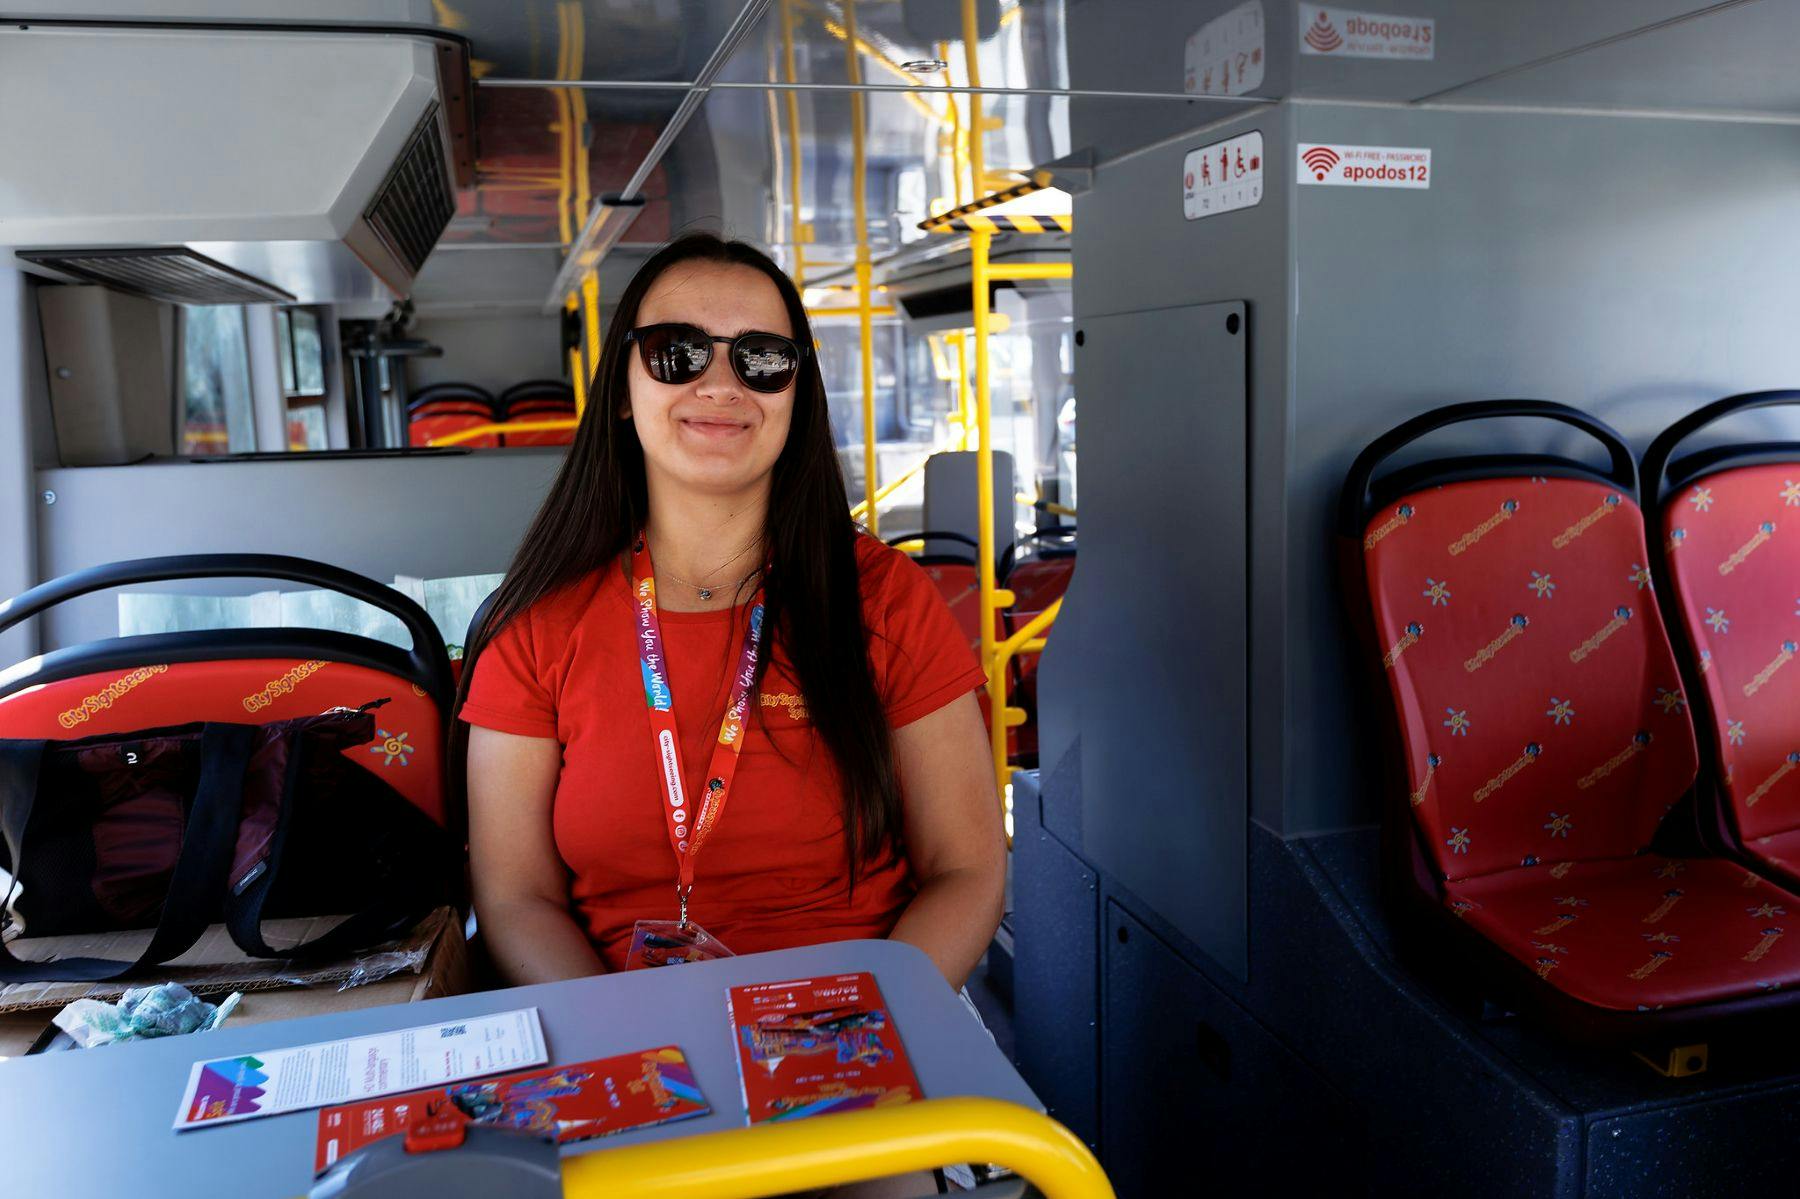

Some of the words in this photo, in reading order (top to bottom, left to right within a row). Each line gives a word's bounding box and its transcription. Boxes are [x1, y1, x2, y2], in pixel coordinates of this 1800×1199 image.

[1363, 152, 1381, 161] FREE
[1343, 164, 1428, 182] apodos12
[639, 580, 651, 597] We
[639, 598, 653, 627] Show
[641, 629, 657, 652] You
[646, 653, 661, 670] the
[651, 672, 670, 712] World!
[723, 723, 740, 742] We
[739, 664, 756, 688] You
